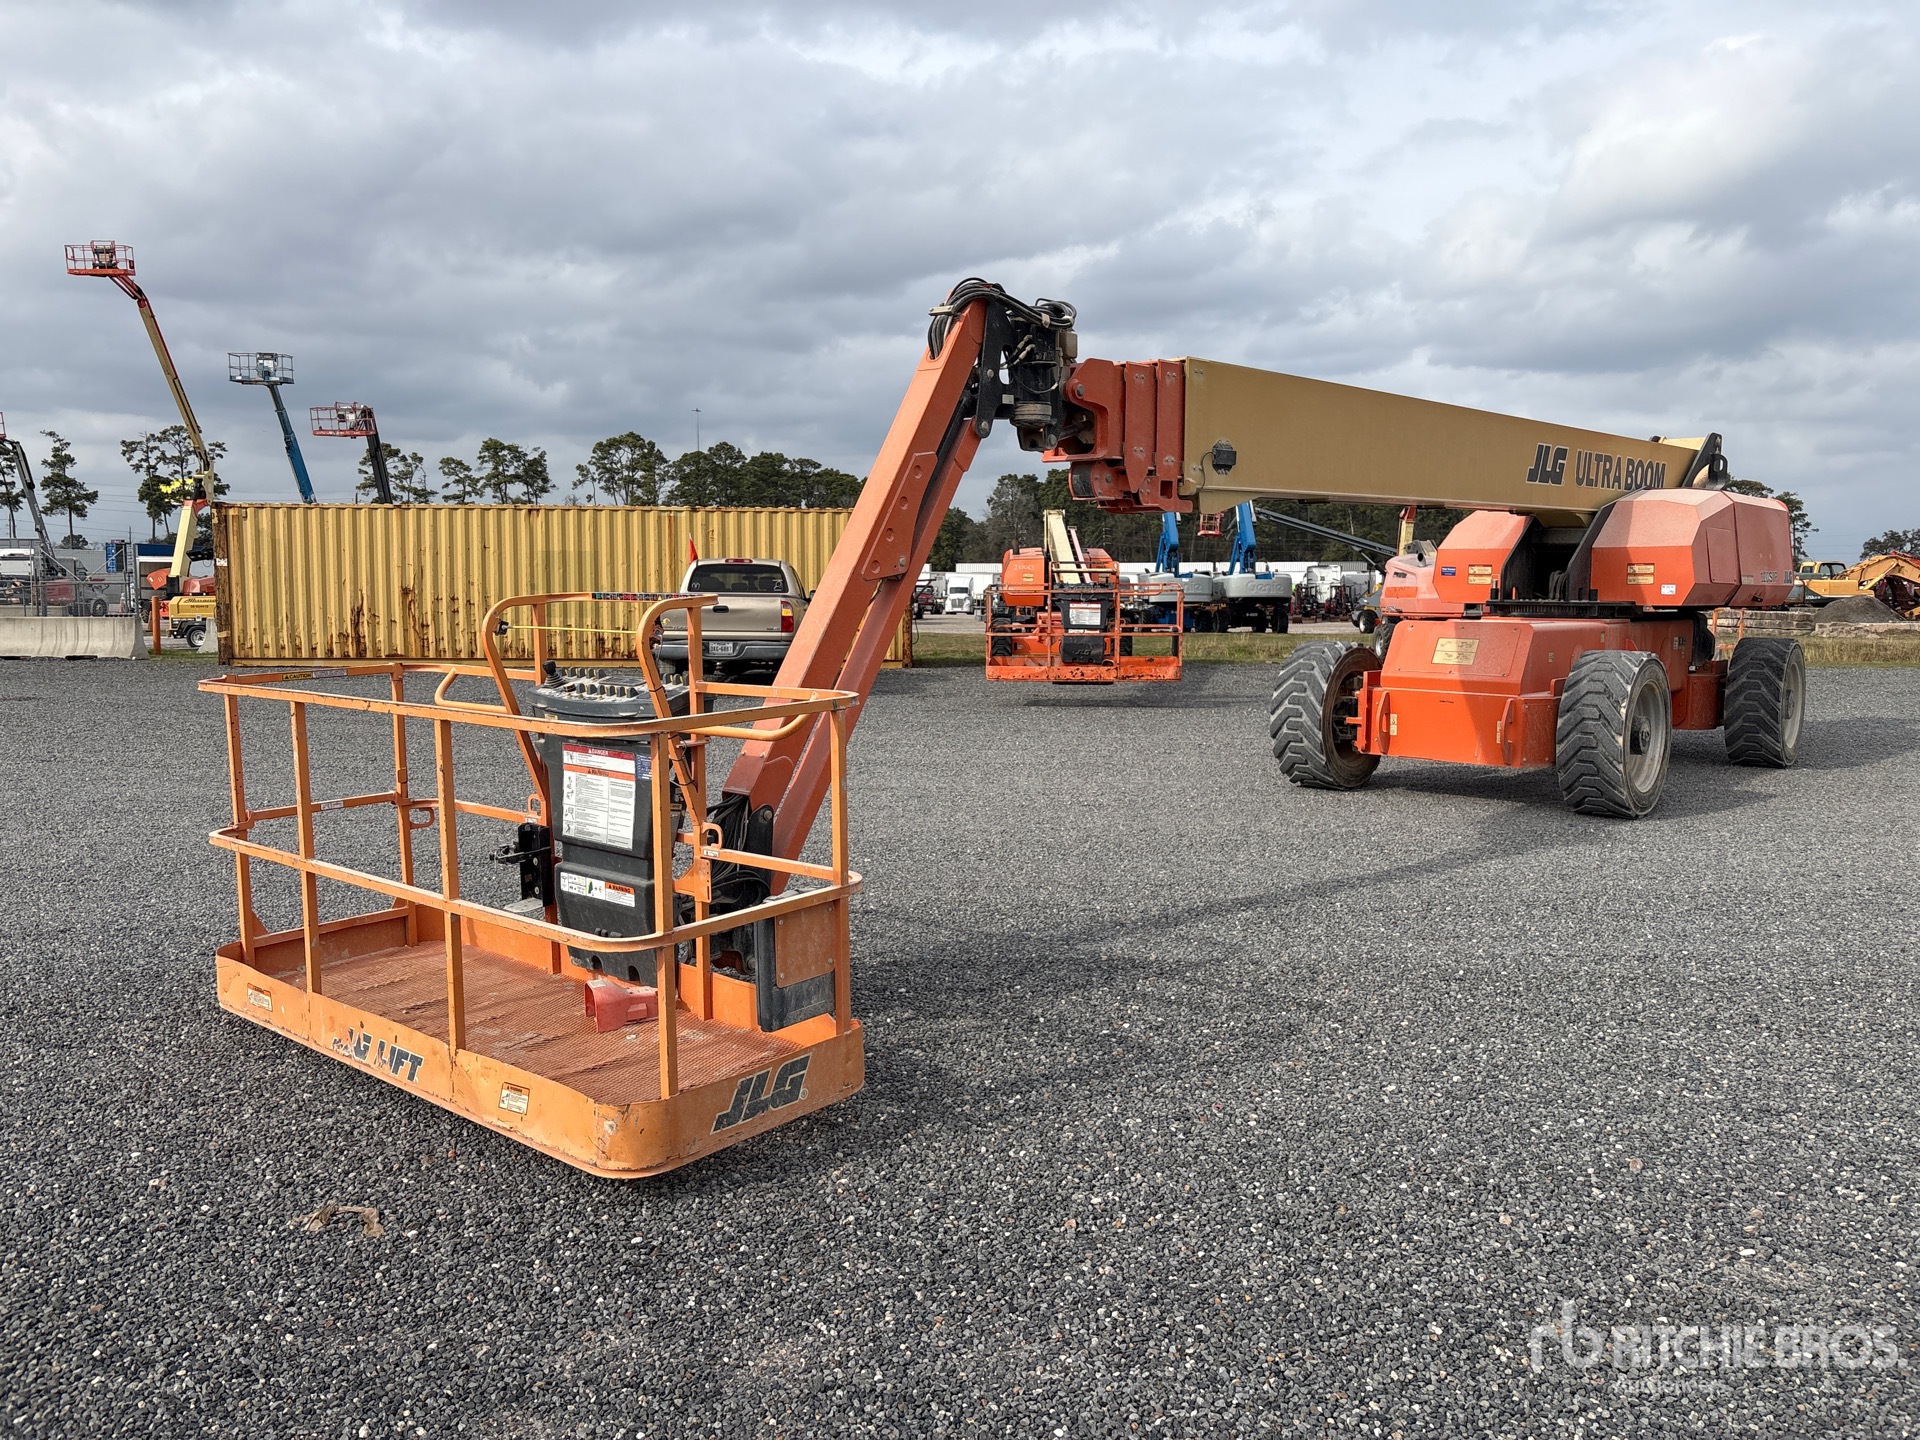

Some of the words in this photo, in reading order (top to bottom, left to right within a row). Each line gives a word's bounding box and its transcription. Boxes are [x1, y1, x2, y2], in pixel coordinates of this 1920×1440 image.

[1526, 443, 1569, 486] JLG
[1575, 449, 1622, 491] ULTRA
[1623, 456, 1667, 491] BOOM
[1245, 580, 1285, 594] Genie
[289, 672, 312, 680] CAUTION
[591, 748, 609, 756] DANGER
[612, 884, 631, 894] WARNING
[710, 1052, 812, 1135] JLG
